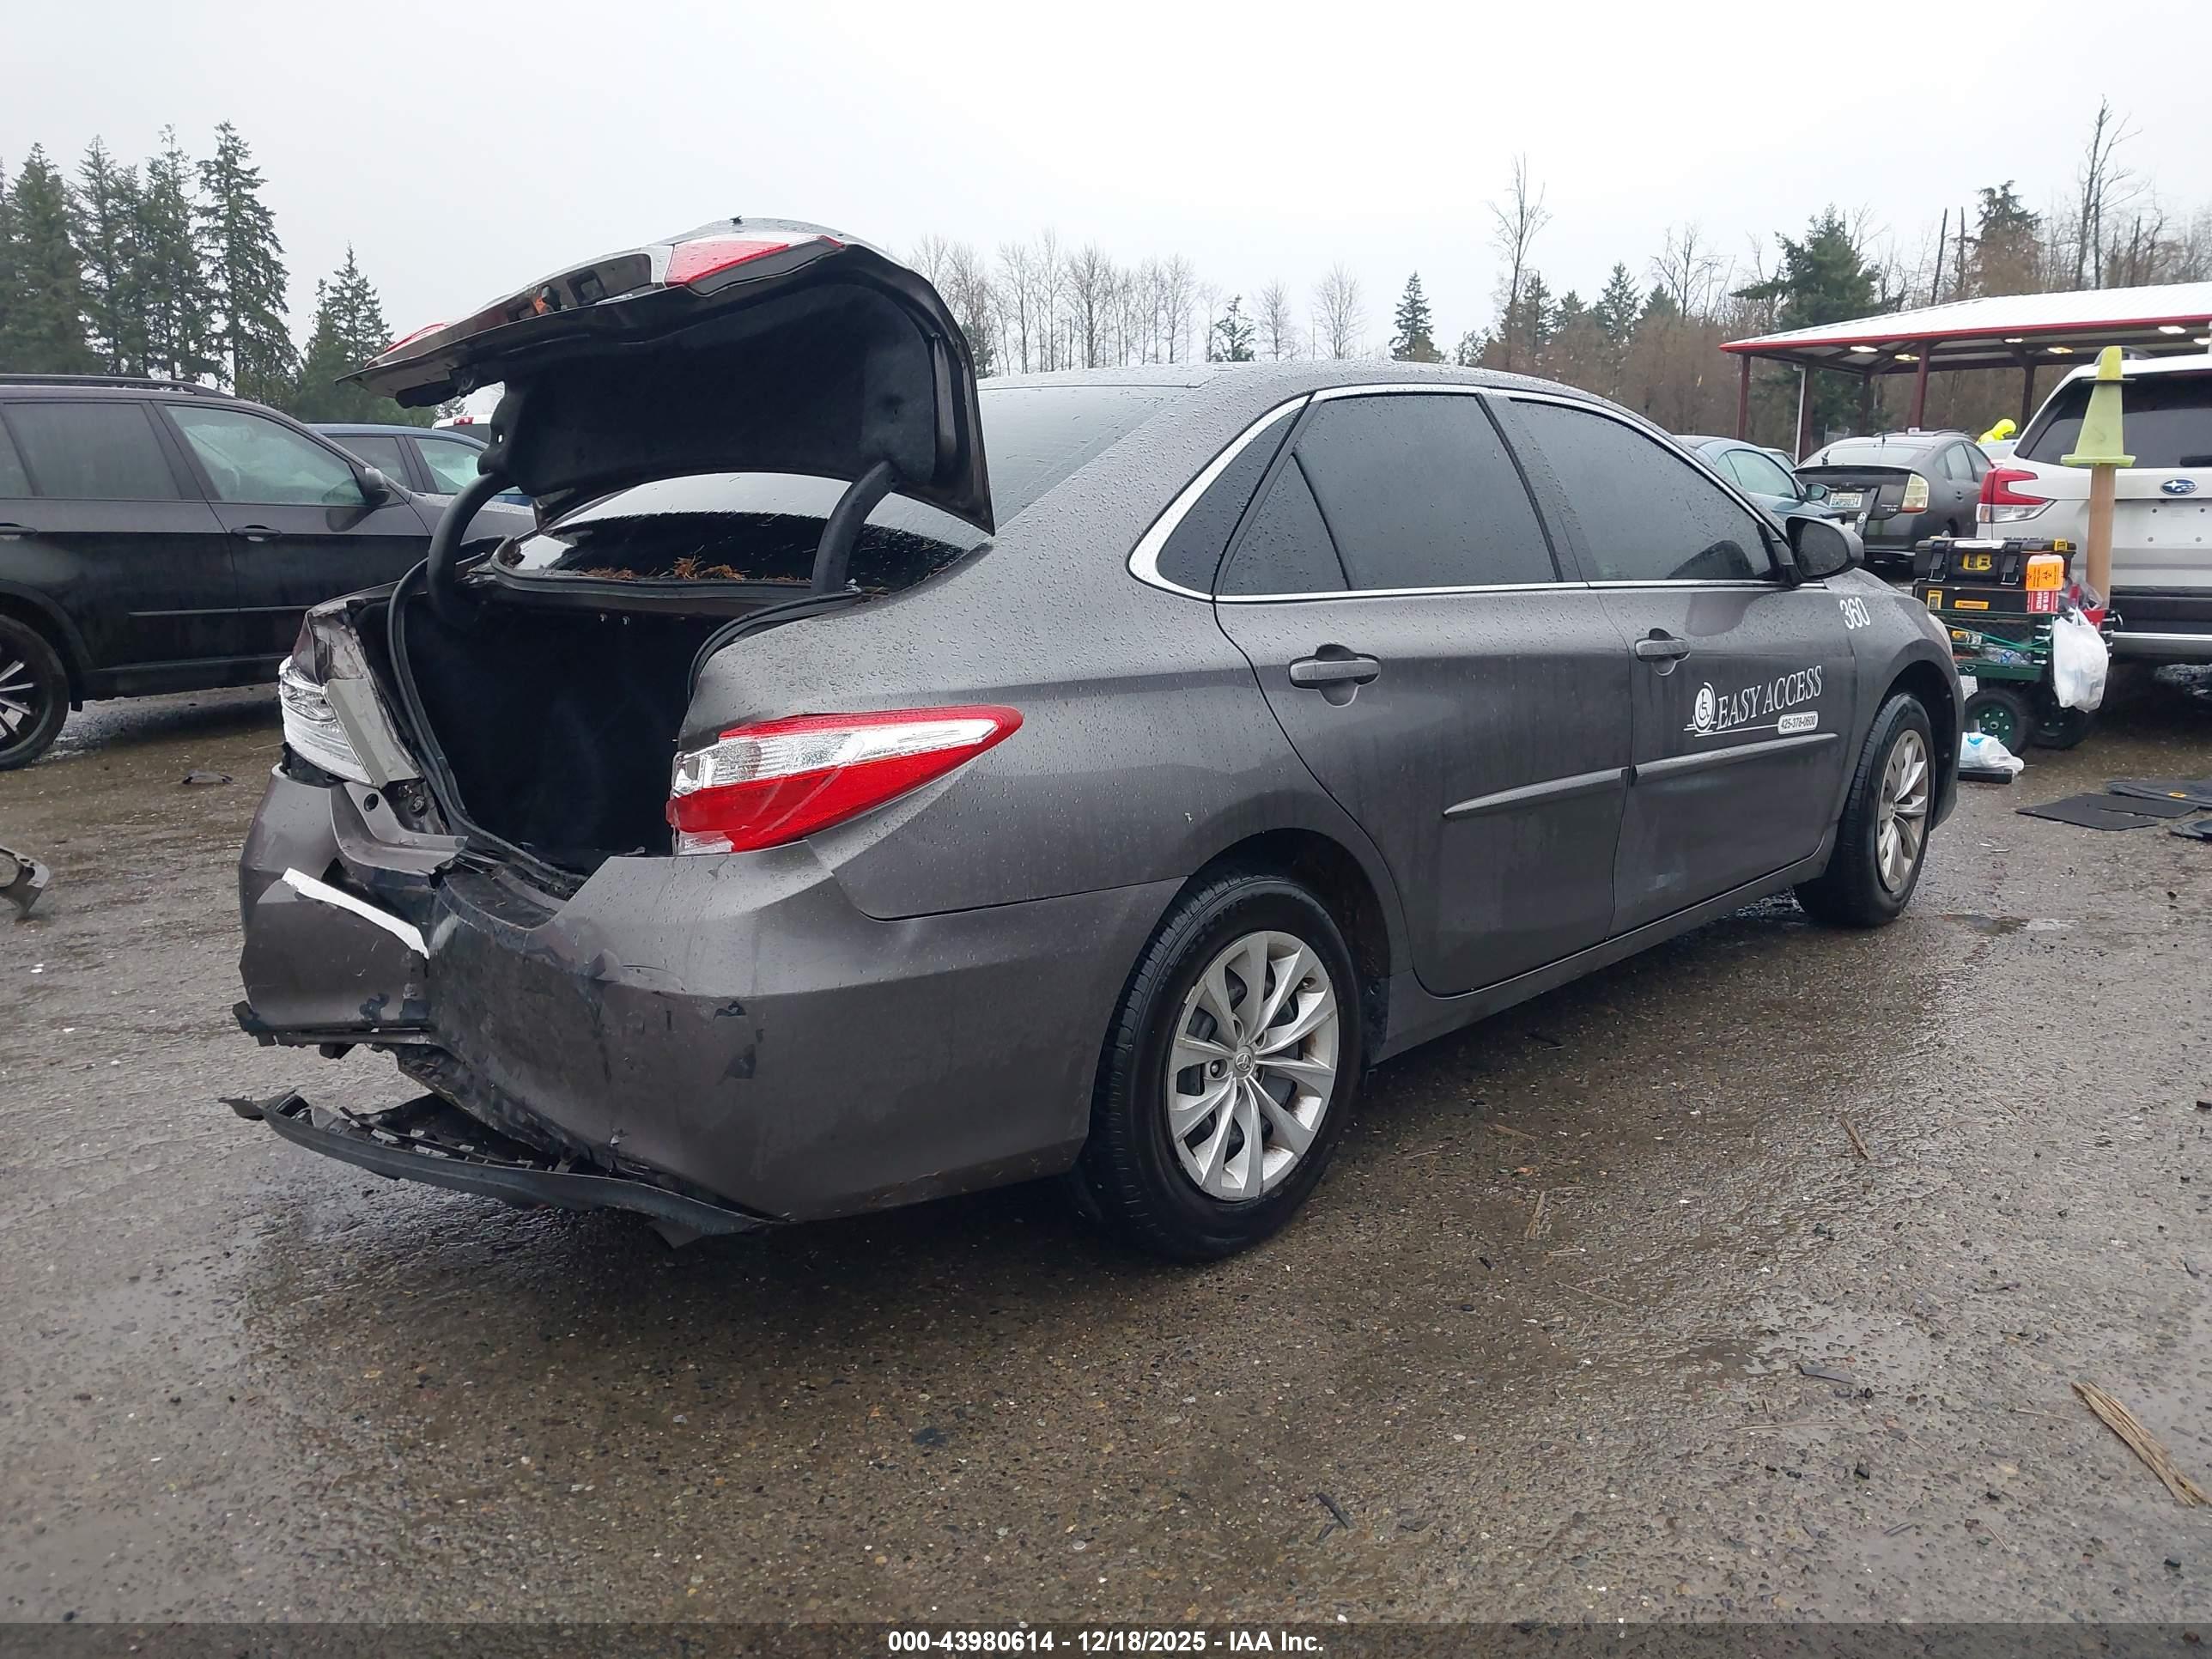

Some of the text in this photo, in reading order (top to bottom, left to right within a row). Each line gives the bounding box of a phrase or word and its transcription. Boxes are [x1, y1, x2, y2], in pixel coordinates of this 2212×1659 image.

[1839, 597, 1871, 629] 360
[1717, 665, 1822, 730] EASY ACCESS
